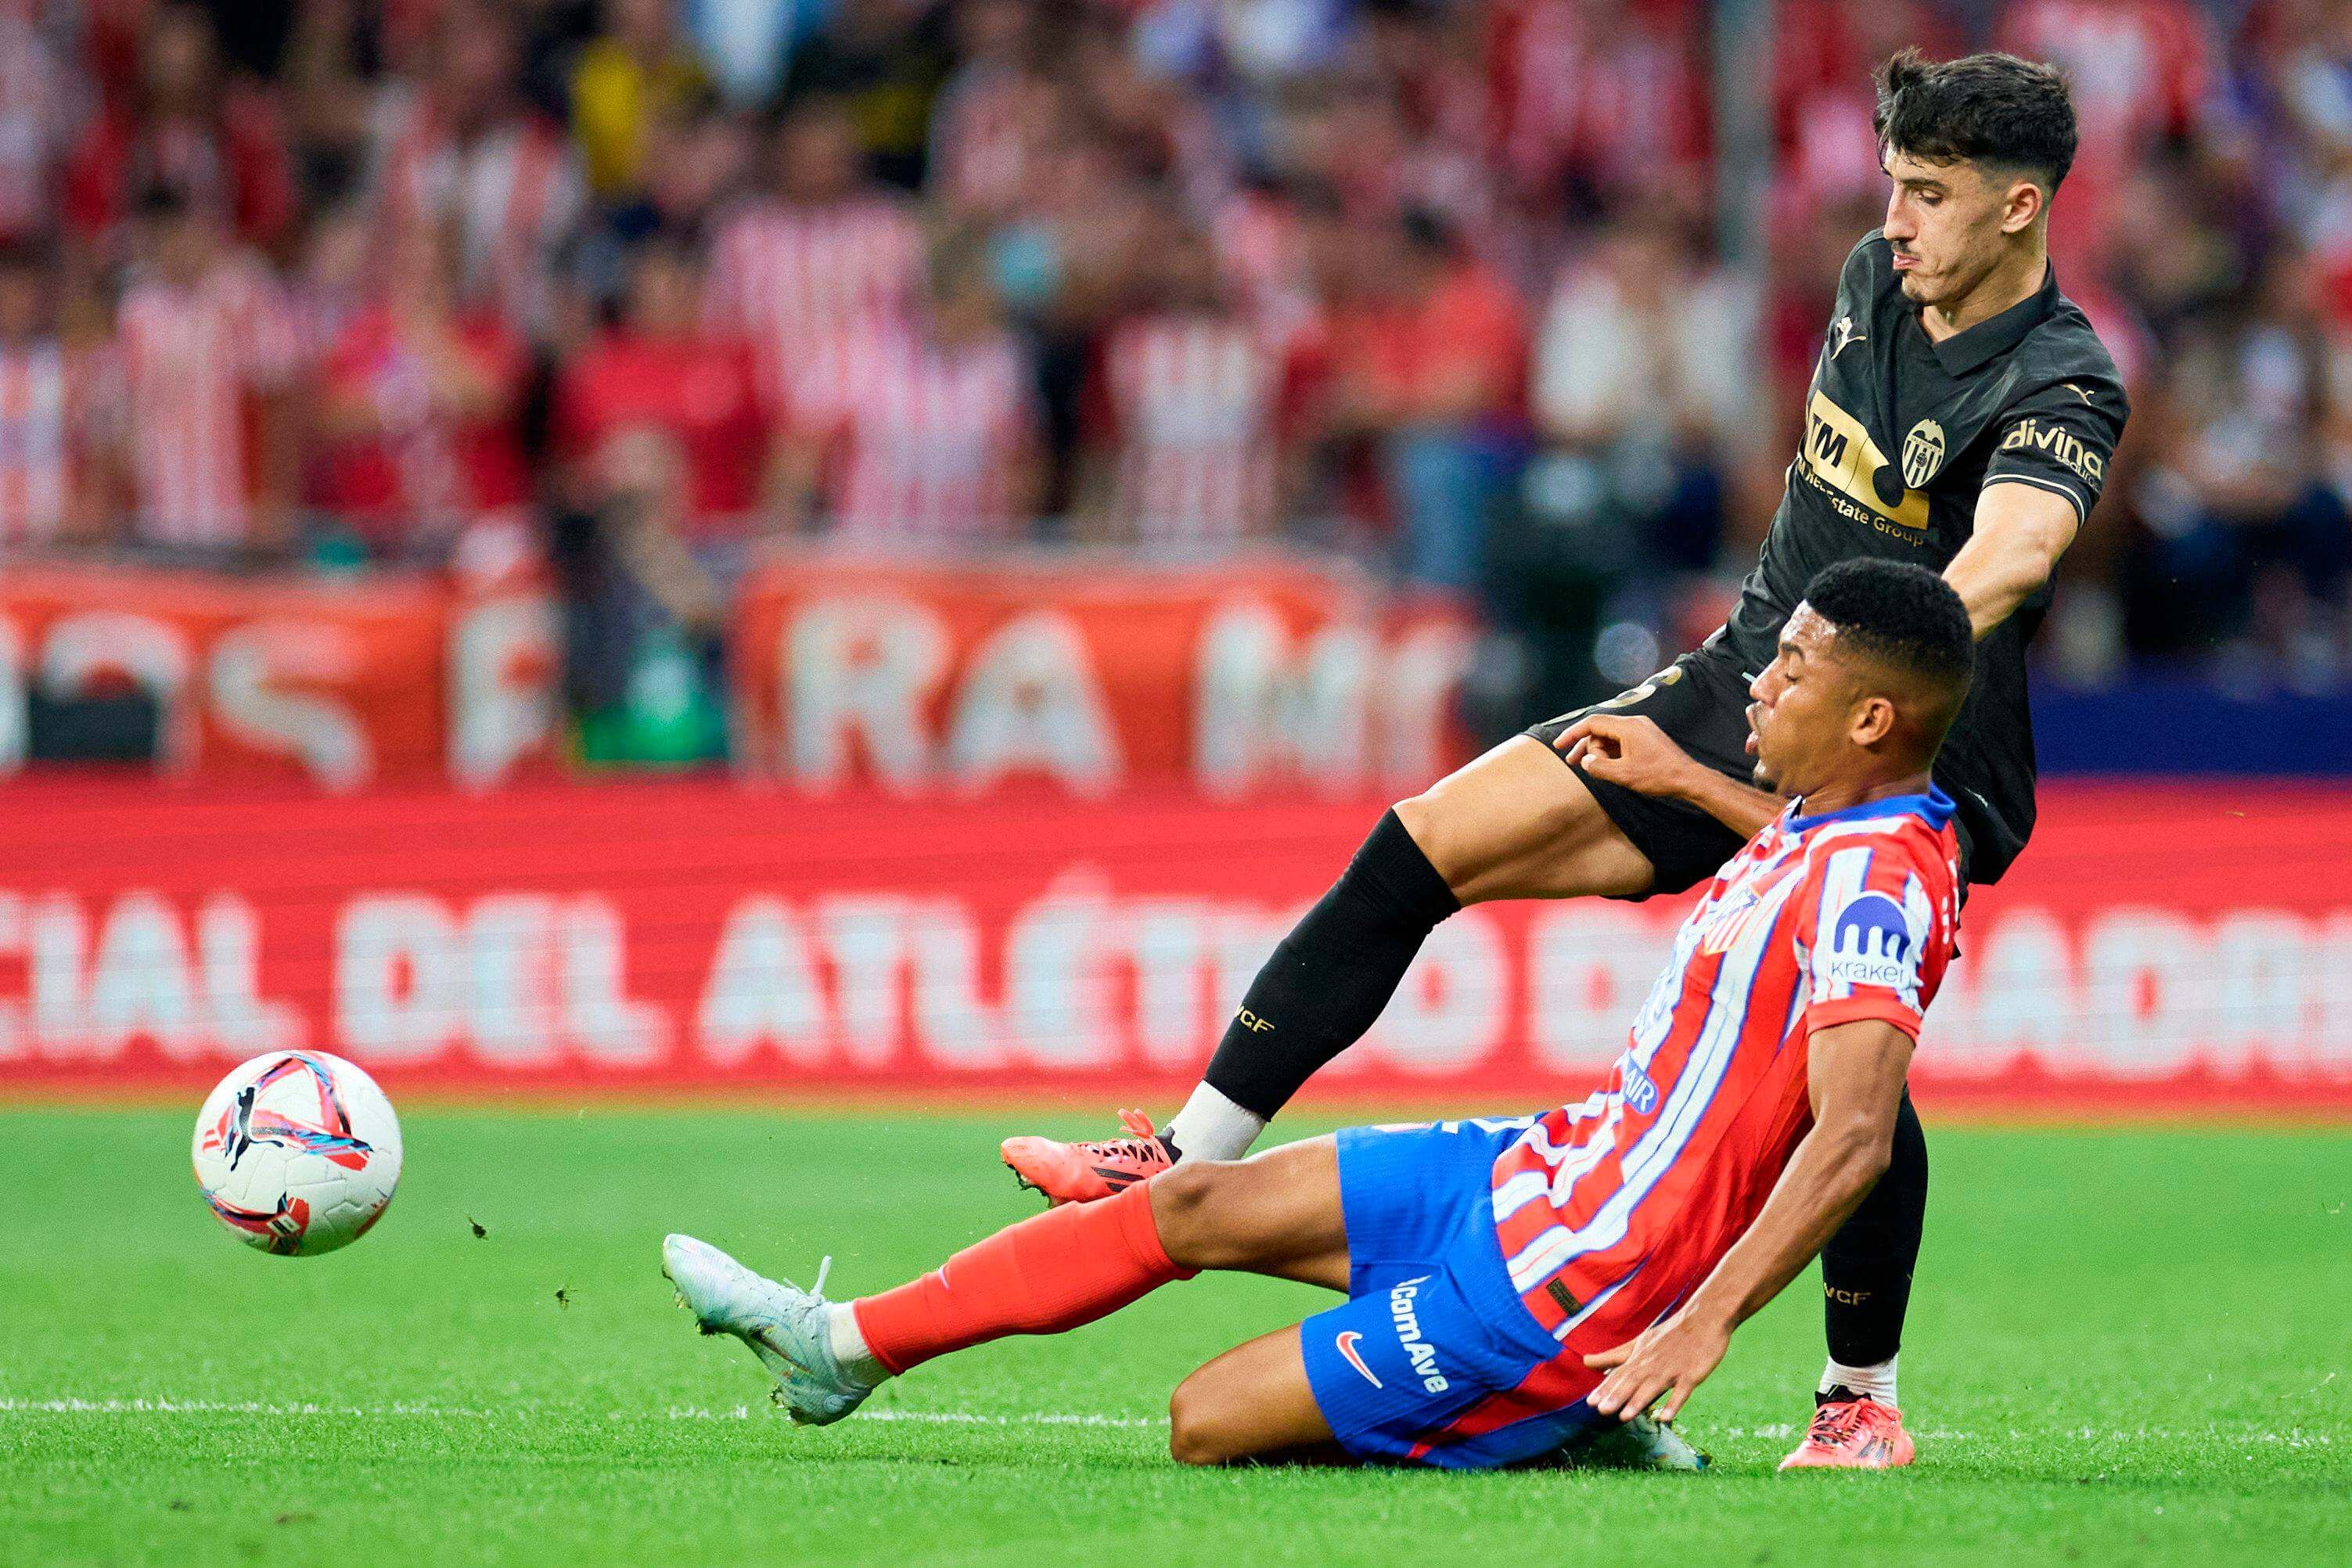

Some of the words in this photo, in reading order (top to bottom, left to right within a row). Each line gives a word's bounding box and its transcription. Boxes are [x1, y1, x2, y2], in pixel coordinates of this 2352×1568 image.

[2002, 419, 2103, 480] divina
[1873, 516, 1924, 547] Group
[330, 890, 678, 1067] DEL
[695, 864, 1510, 1075] ATLÉTIO
